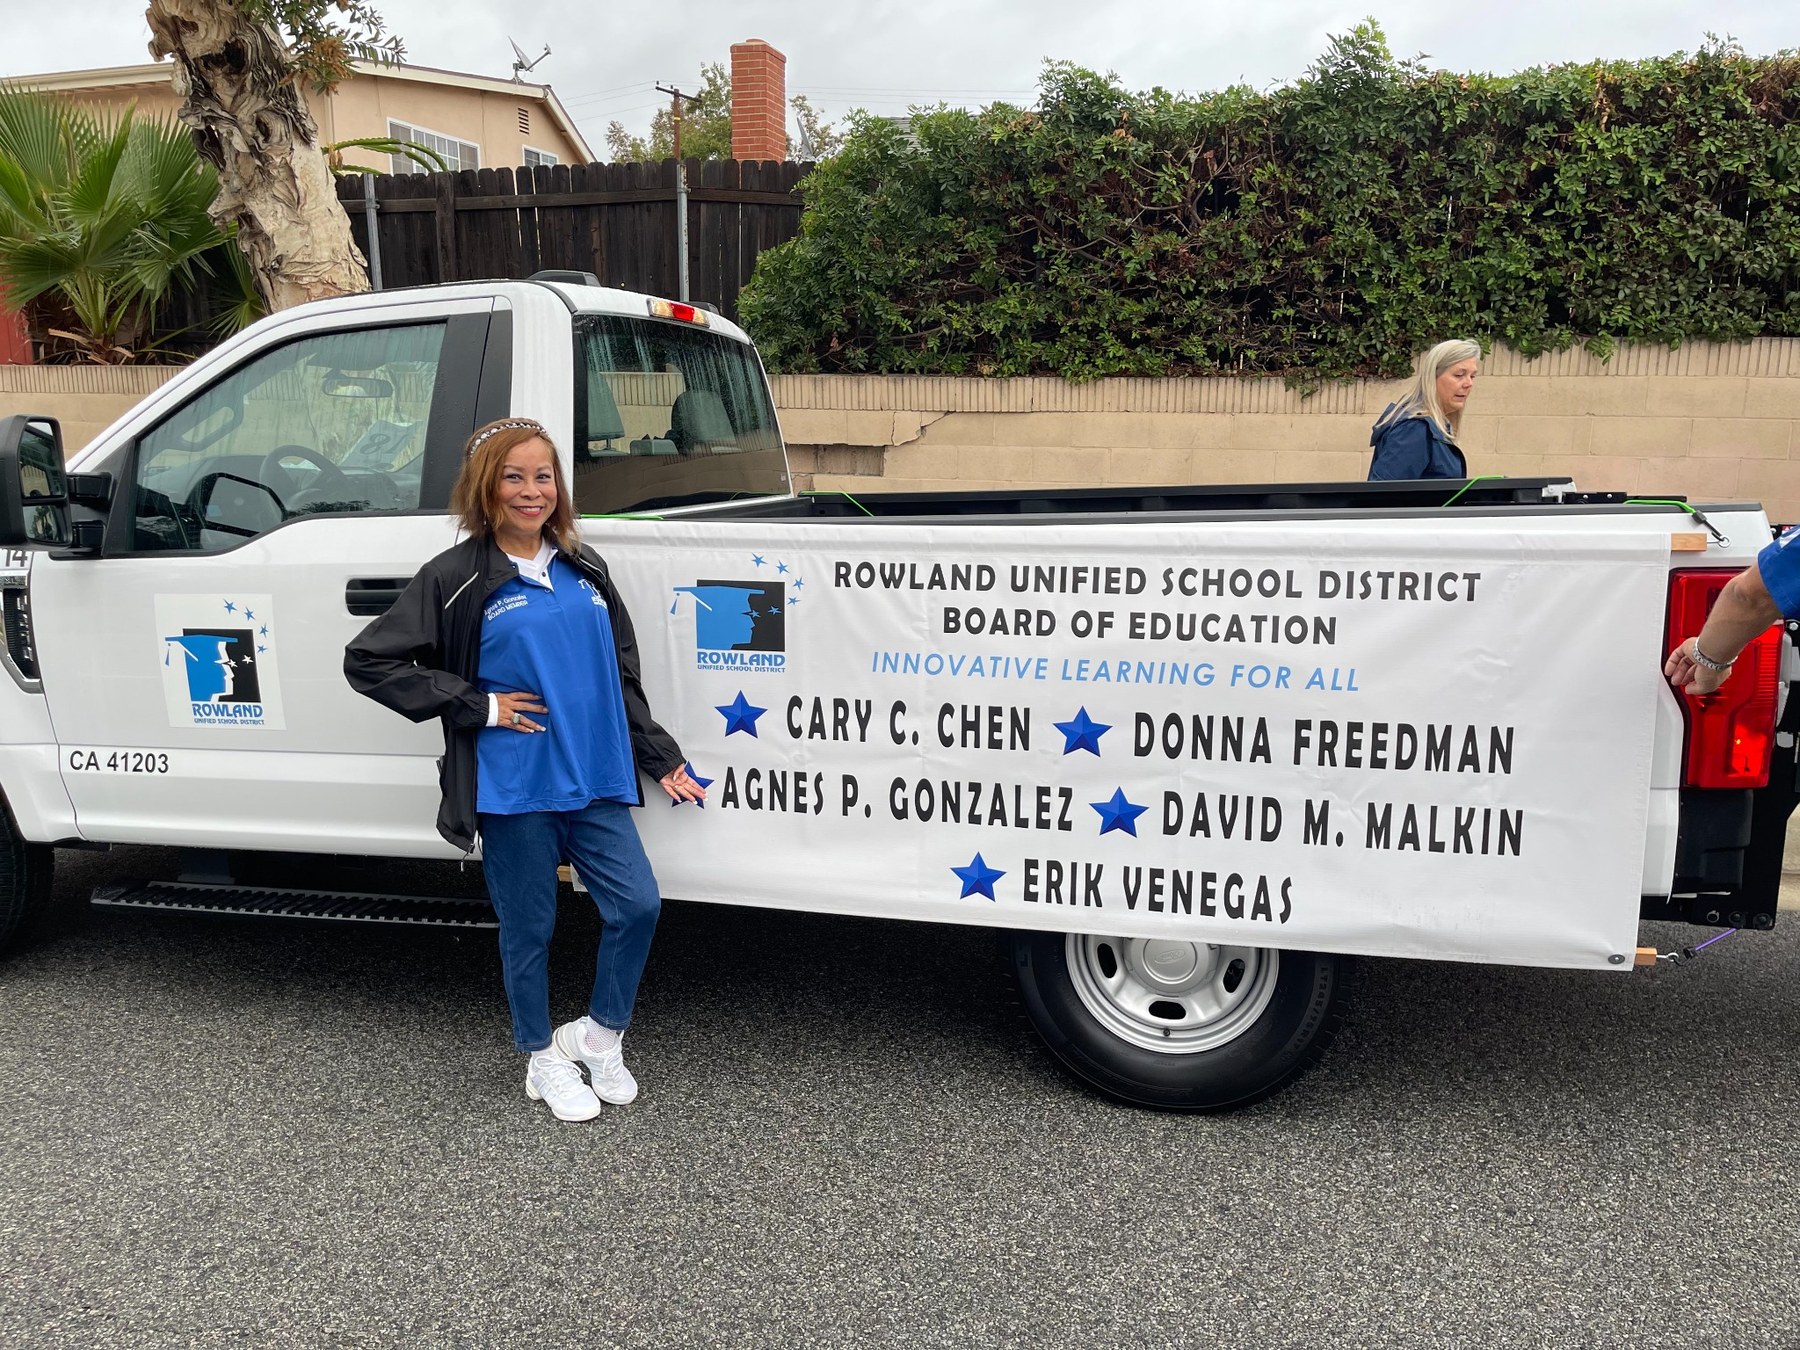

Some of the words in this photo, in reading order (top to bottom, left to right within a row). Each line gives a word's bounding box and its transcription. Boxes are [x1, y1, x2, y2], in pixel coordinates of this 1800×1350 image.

[834, 561, 996, 592] ROWLAND
[1010, 565, 1147, 595] UNIFIED
[1161, 567, 1303, 599] SCHOOL
[1318, 570, 1482, 602] DISTRICT
[487, 606, 506, 621] BOARD
[943, 606, 1056, 637] BOARD
[1070, 609, 1115, 639] OF
[1128, 611, 1337, 645] EDUCATION
[697, 652, 786, 667] ROWLAND
[872, 652, 1048, 680] INNOVATIVE
[1061, 659, 1215, 687] LEARNING
[1231, 664, 1291, 689] FOR
[1306, 667, 1359, 692] ALL
[192, 704, 263, 718] ROWLAND
[786, 695, 872, 743] CARY
[889, 700, 919, 746] C.
[937, 702, 1031, 752] CHEN
[70, 750, 100, 771] CA
[107, 752, 169, 774] 41203
[1133, 711, 1272, 764] DONNA
[1293, 719, 1514, 775] FREEDMAN
[721, 766, 824, 816] AGNES
[841, 774, 872, 819] P.
[889, 776, 1073, 832] GONZALEZ
[1162, 790, 1283, 843] DAVID
[1303, 798, 1344, 848] M.
[1365, 802, 1524, 857] MALKIN
[1023, 858, 1104, 908] ERIK
[1122, 865, 1293, 925] VENEGAS
